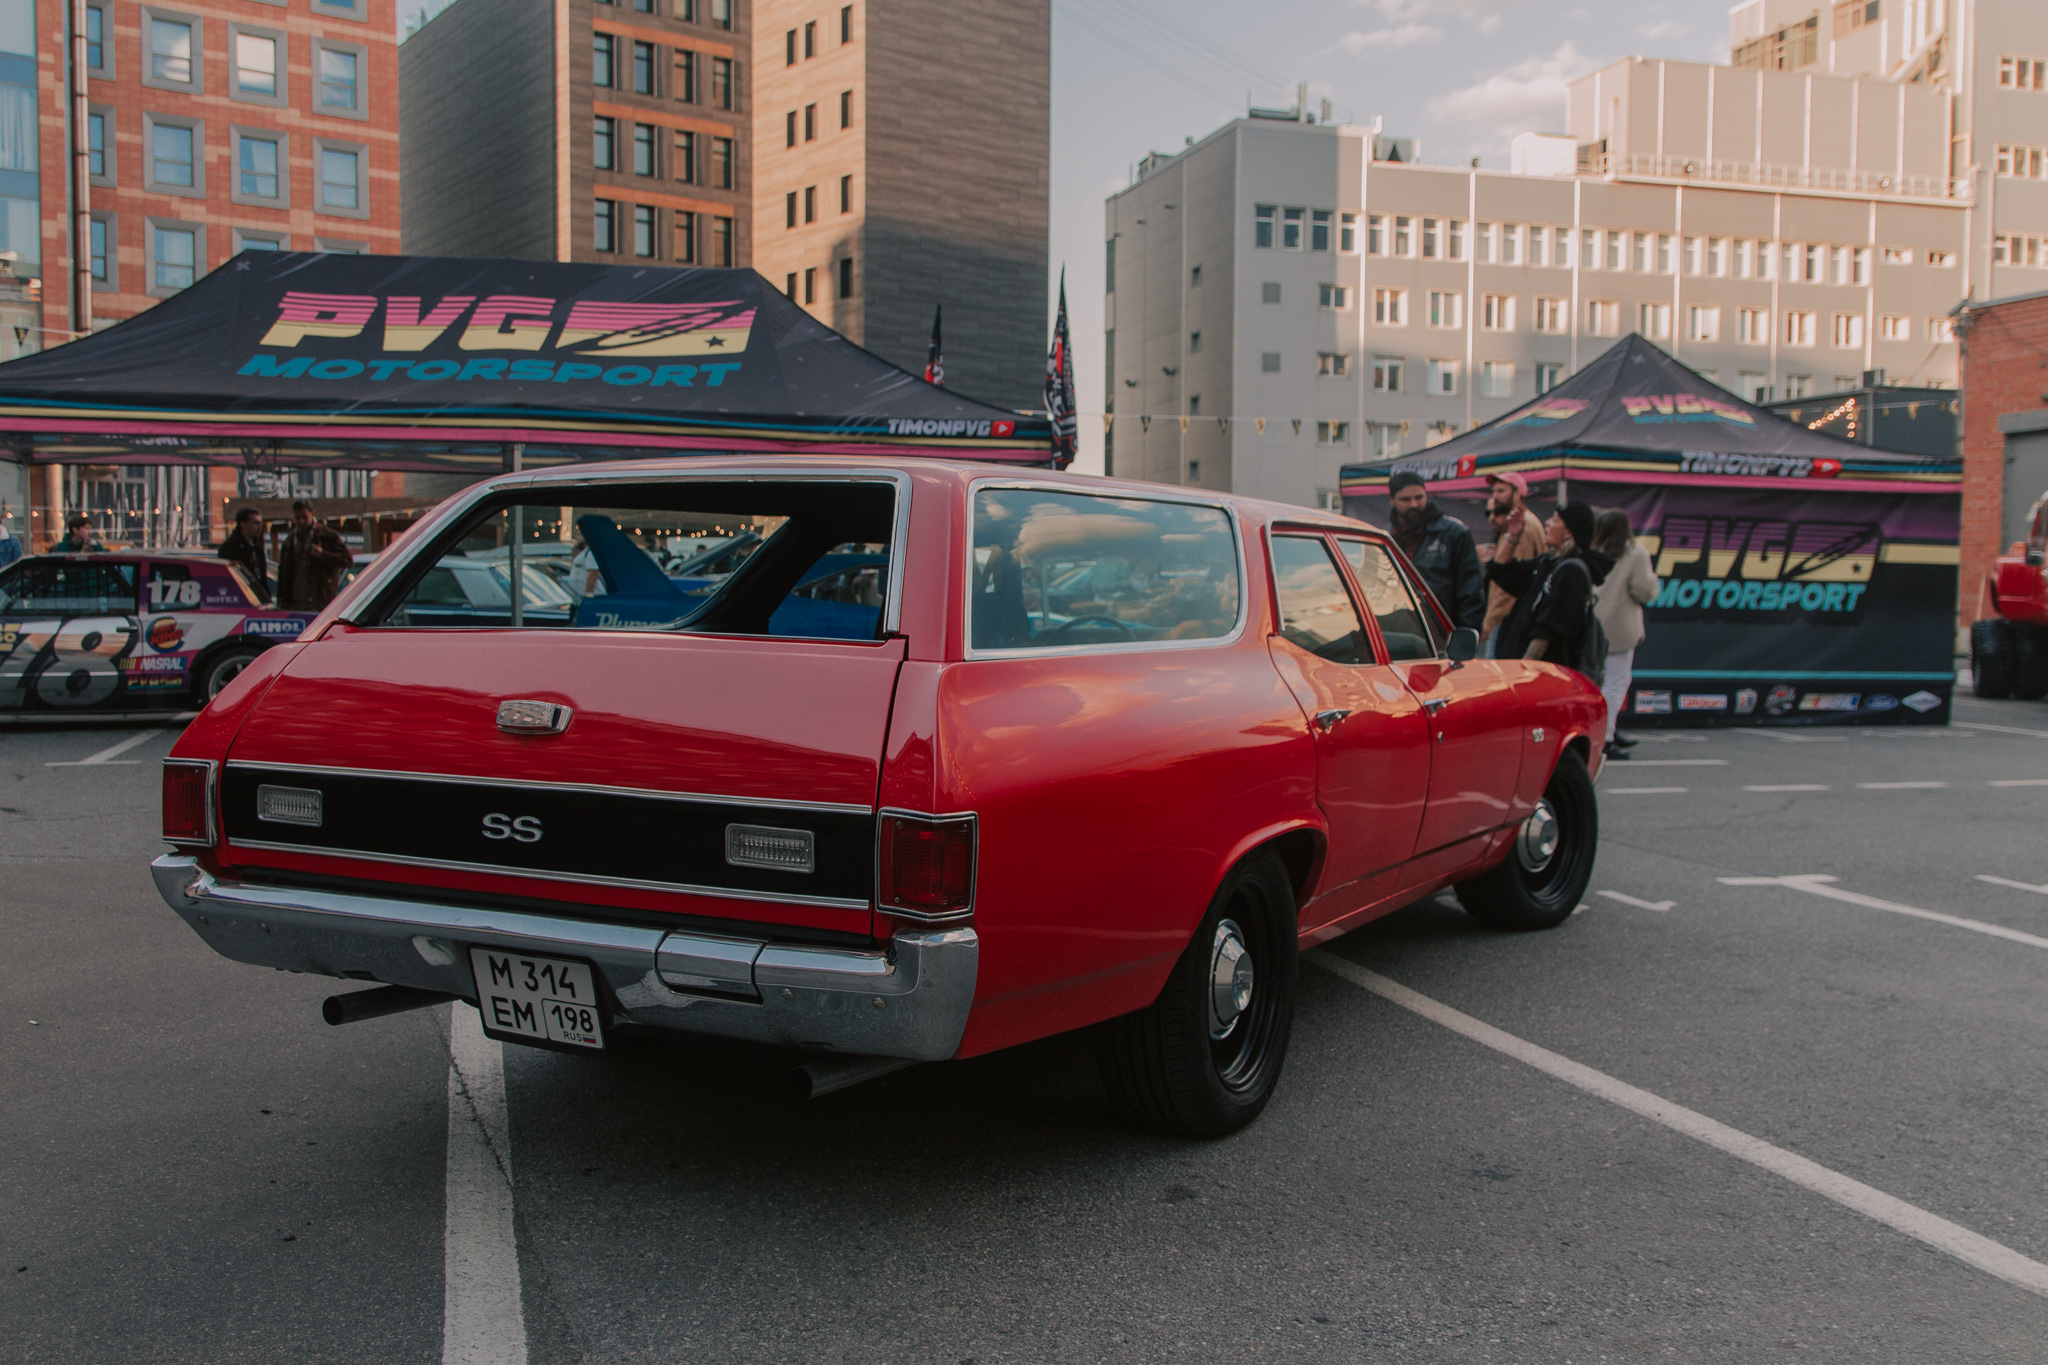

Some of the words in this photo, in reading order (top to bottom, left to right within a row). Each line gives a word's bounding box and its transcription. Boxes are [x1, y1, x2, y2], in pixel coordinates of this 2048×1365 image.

[258, 291, 556, 351] PVG
[236, 354, 742, 387] MOTORSPORT
[1621, 393, 1704, 416] PVG
[887, 419, 992, 437] TIMONPVG
[1680, 449, 1814, 477] TIMONPVG
[1655, 516, 1791, 580] PVG
[147, 580, 202, 604] 178
[1646, 578, 1867, 612] MOTORSPORT
[247, 621, 302, 634] AIMOL
[140, 656, 184, 671] NASRAL
[481, 812, 543, 843] SS
[488, 954, 515, 989] M
[520, 960, 577, 999] 314
[490, 995, 538, 1032] EM
[550, 1004, 594, 1033] 198
[563, 1030, 583, 1042] RUS
